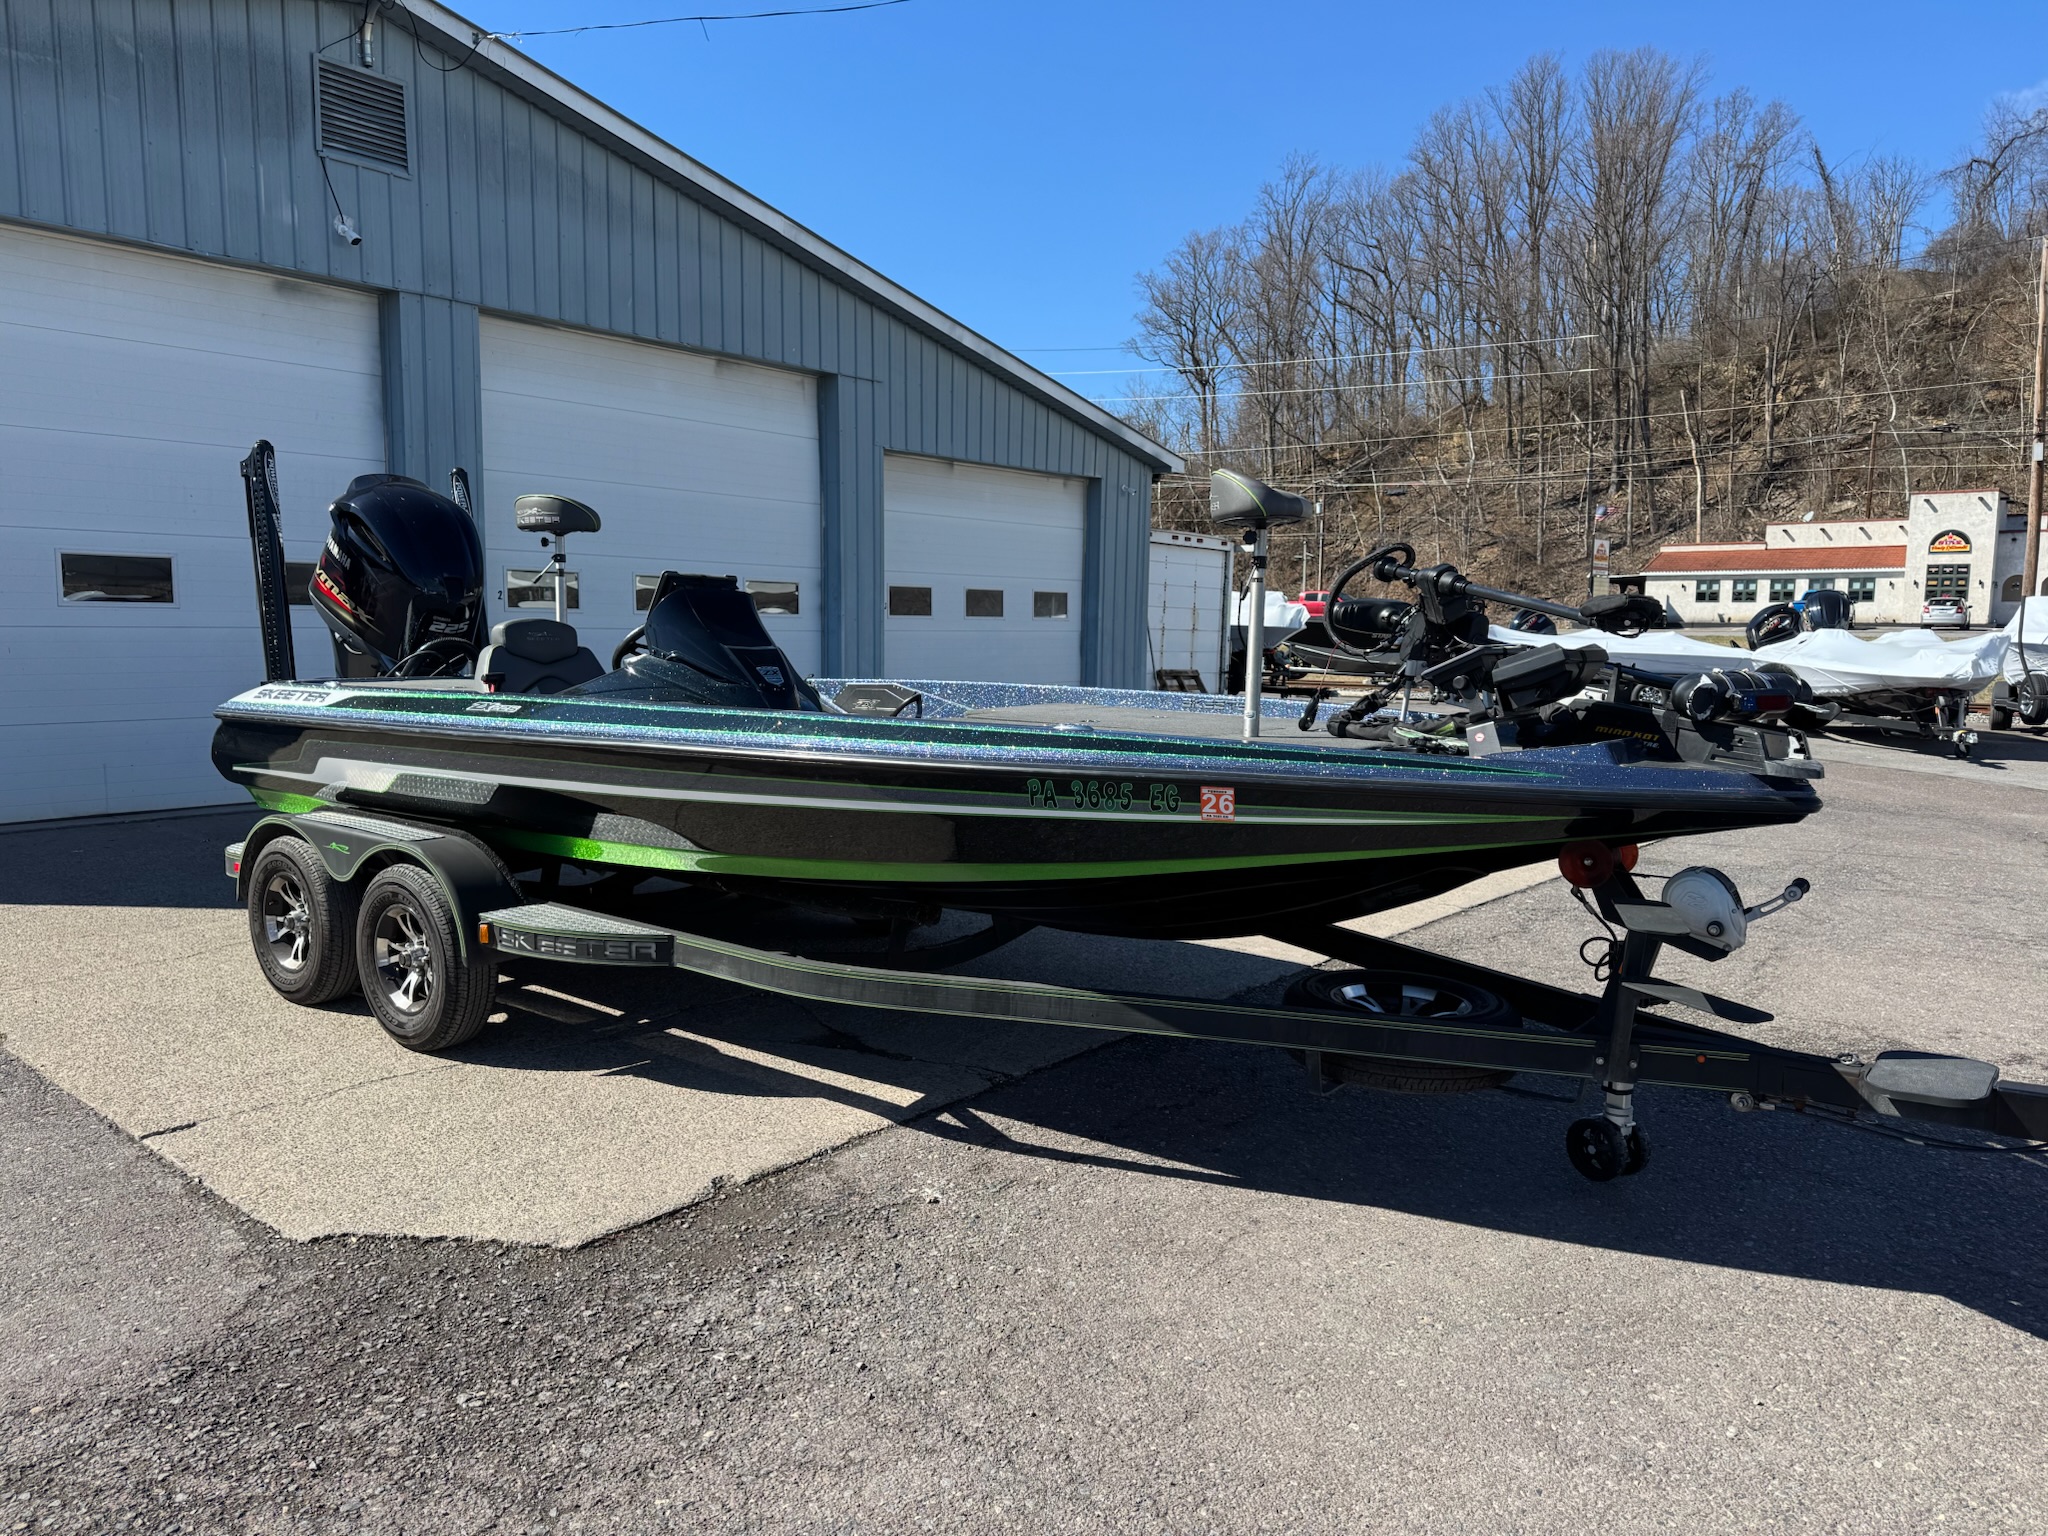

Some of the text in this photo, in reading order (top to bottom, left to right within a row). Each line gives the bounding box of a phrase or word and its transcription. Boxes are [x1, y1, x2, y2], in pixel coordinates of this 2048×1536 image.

[497, 590, 504, 600] 2
[428, 620, 470, 634] 225
[253, 688, 332, 703] SKEETER
[1026, 778, 1182, 814] PA 3685 EG
[1202, 793, 1234, 815] 26
[501, 928, 657, 961] SKEETER
